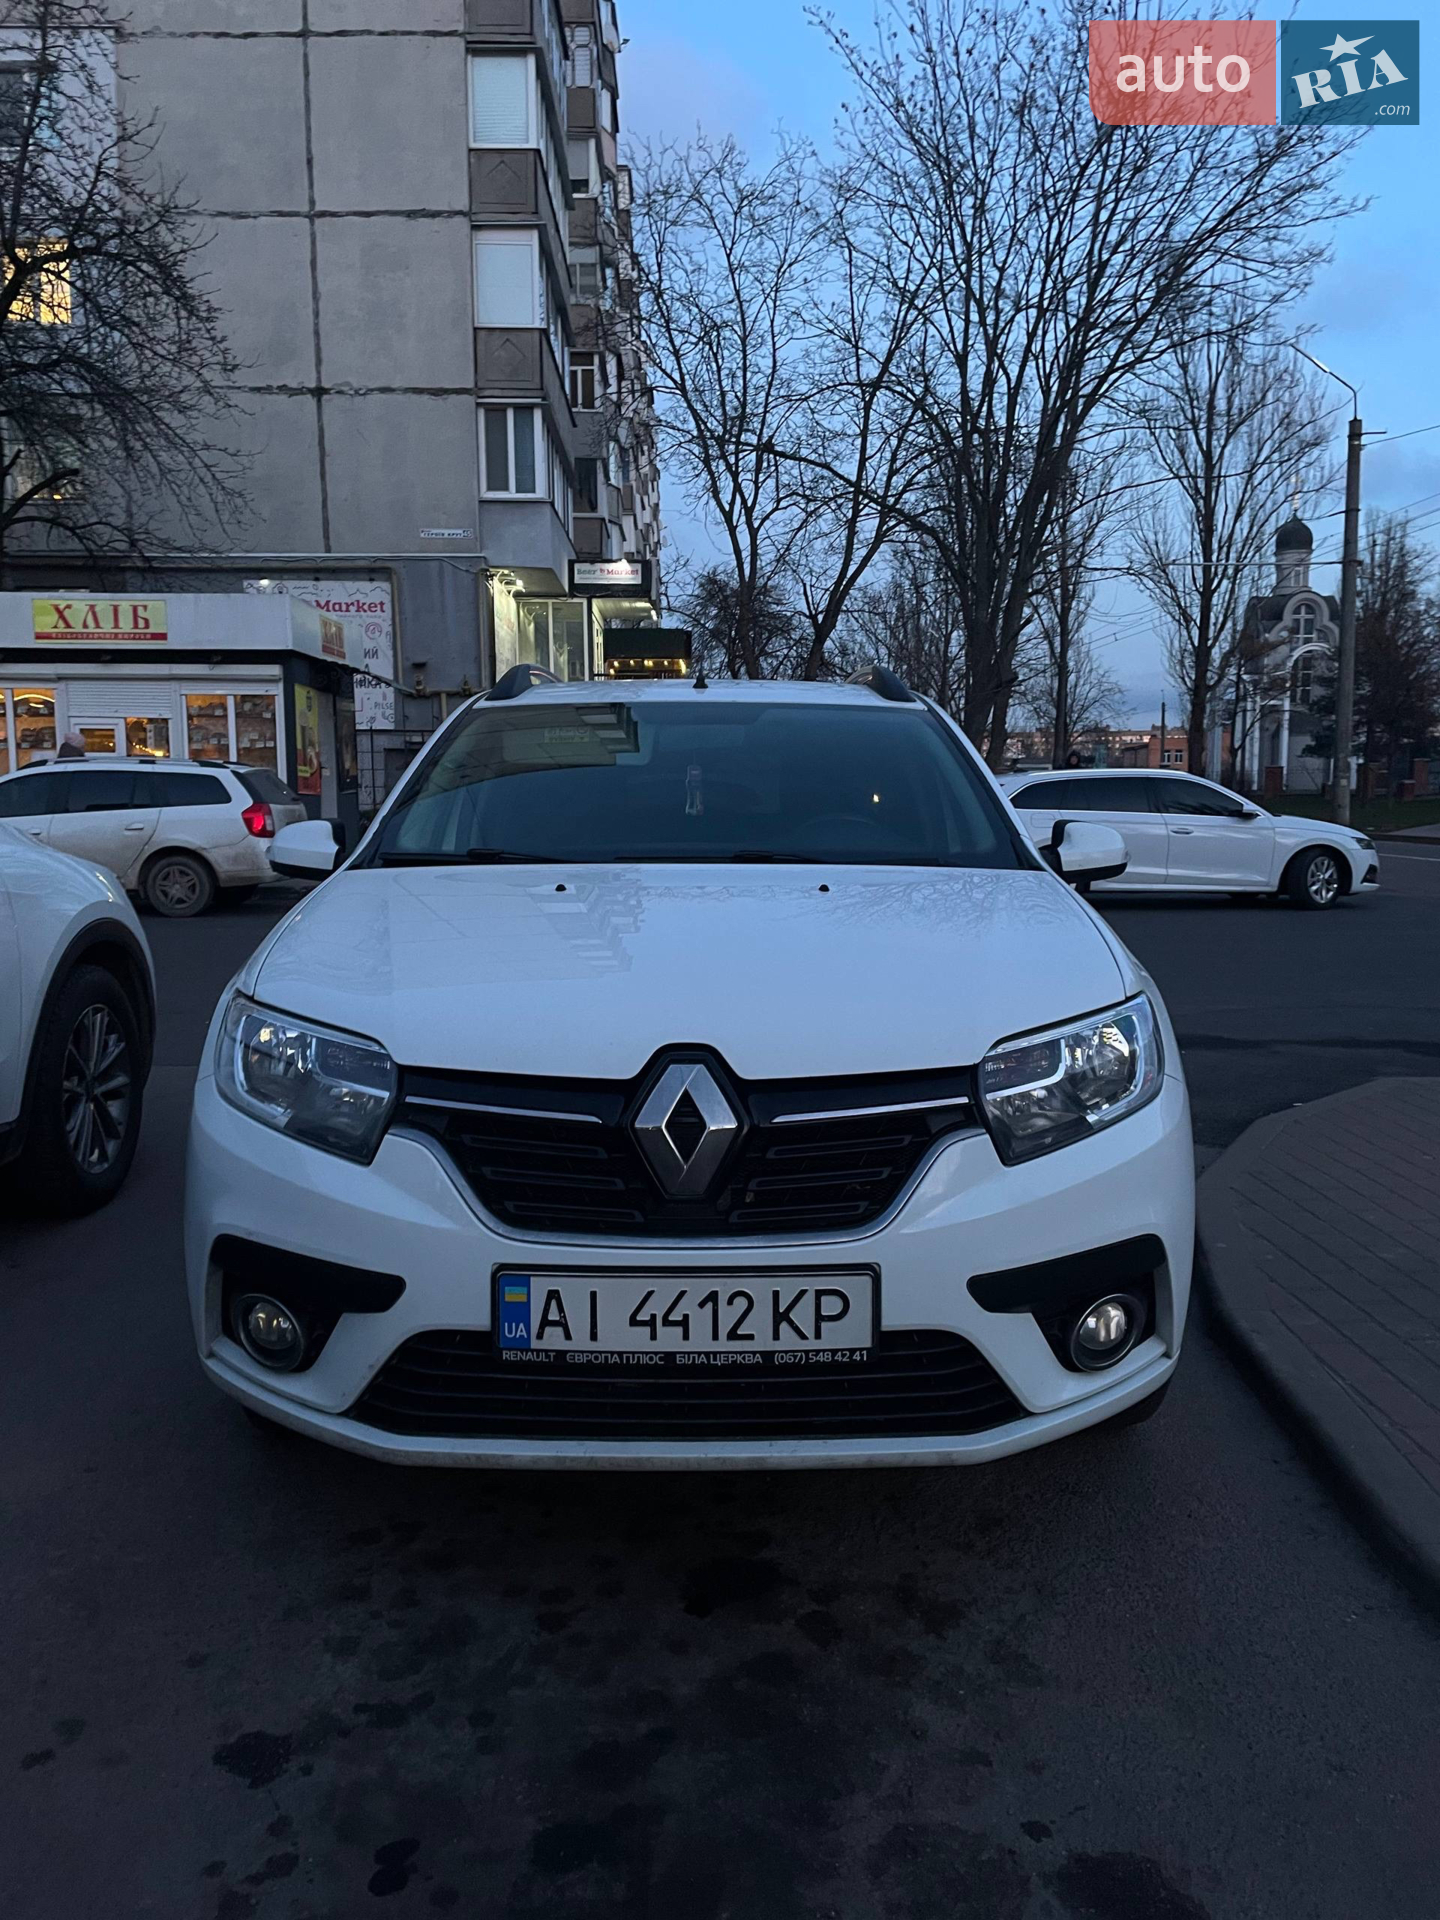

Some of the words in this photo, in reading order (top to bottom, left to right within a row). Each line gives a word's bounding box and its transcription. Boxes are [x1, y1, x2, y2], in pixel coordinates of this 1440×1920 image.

[314, 599, 386, 613] Market
[49, 603, 151, 630] ХЛІБ
[535, 1288, 598, 1342] AI
[628, 1289, 756, 1342] 4412
[772, 1288, 851, 1342] KP
[504, 1322, 528, 1339] UA
[502, 1350, 556, 1363] RENAULT
[566, 1352, 620, 1364] ЄВРОПА
[623, 1353, 665, 1365] ПЛЮС
[676, 1353, 708, 1365] БІЛА
[710, 1353, 763, 1367] ЦЕРКВА
[774, 1351, 806, 1366] (067)
[808, 1351, 832, 1363] 548
[834, 1350, 850, 1363] 42
[852, 1350, 867, 1362] 41
